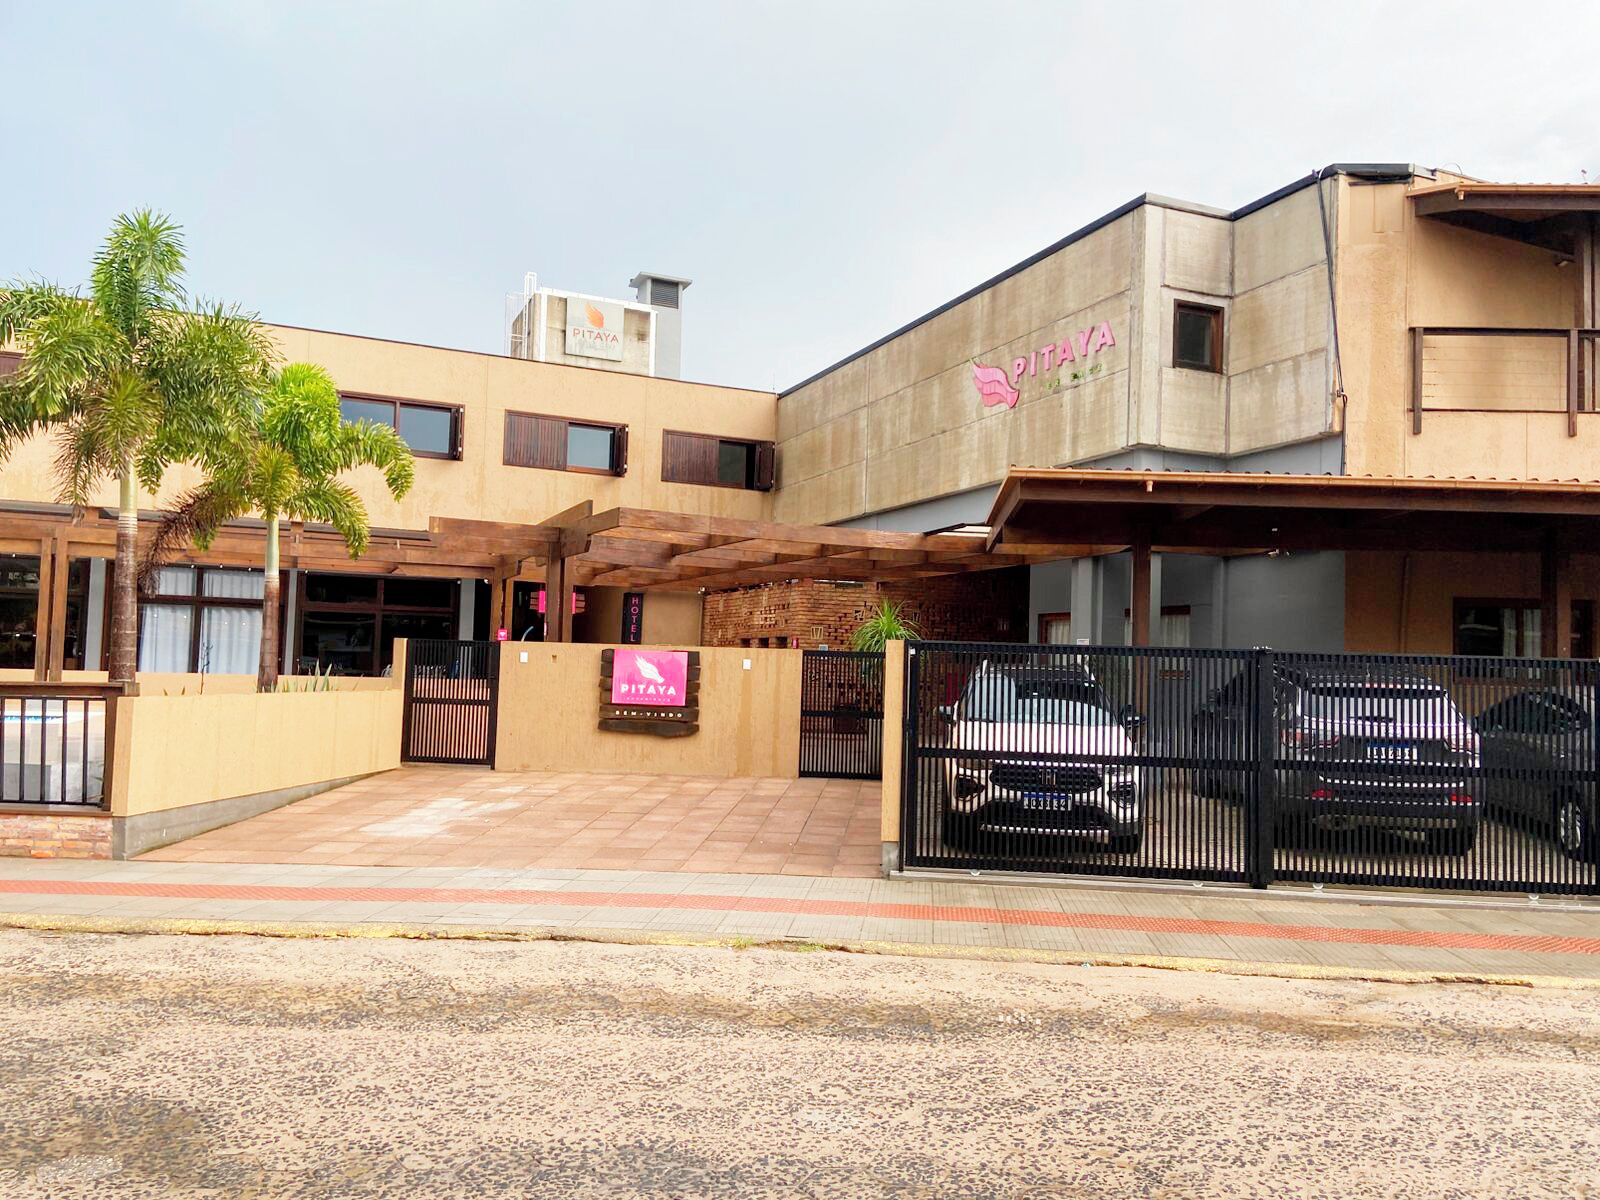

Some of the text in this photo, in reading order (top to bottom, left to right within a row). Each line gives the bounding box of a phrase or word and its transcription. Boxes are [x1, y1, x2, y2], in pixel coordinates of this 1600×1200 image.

[572, 327, 619, 343] PITAYA
[1012, 320, 1116, 384] PITAYA
[630, 597, 639, 642] HOTEL
[620, 683, 677, 696] PITAYA
